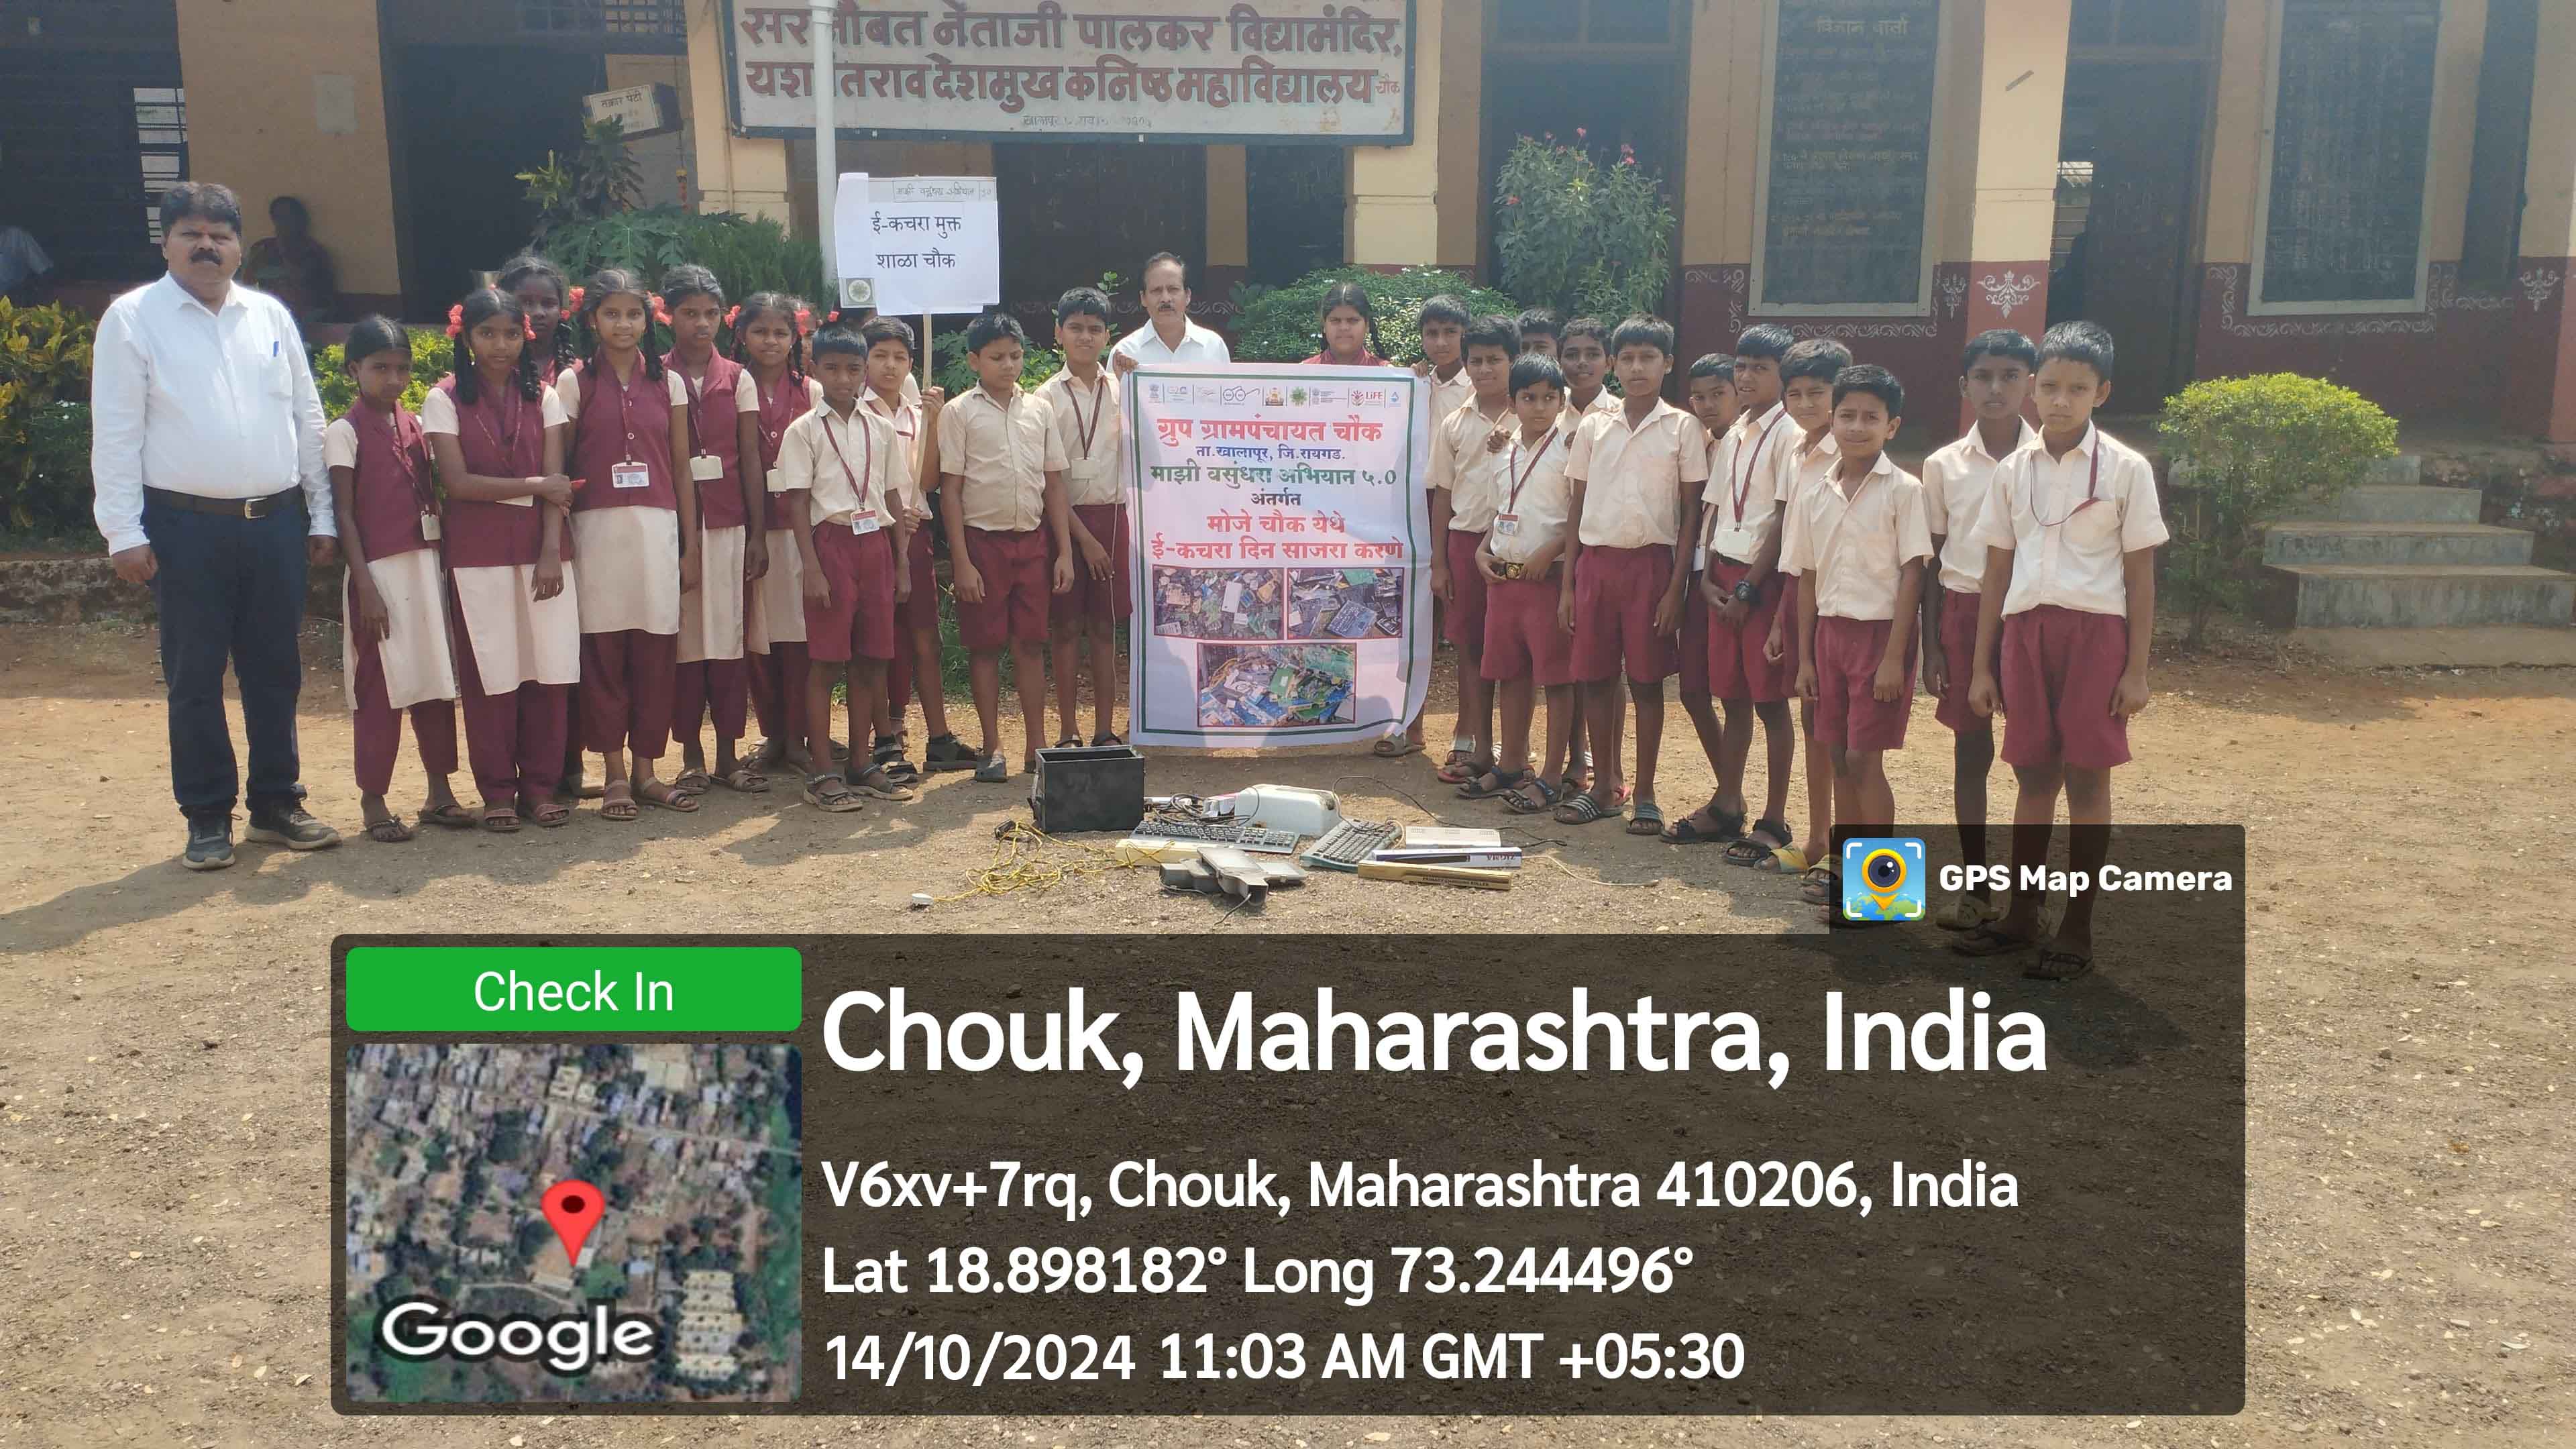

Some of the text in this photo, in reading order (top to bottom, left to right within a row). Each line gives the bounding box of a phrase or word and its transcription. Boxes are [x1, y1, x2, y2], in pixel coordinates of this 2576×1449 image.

[933, 0, 1067, 48] नेताजी
[1073, 15, 1220, 52] पालकर
[1225, 2, 1403, 58] विद्यामंदिर,
[925, 52, 1064, 113] देशमुख
[1065, 54, 1173, 103] कनिष्ठ
[1176, 54, 1379, 108] महाविद्यालय
[871, 211, 962, 239] ई-कचरा मुक्त
[875, 247, 956, 268] शाळा चौक
[1157, 413, 1383, 447] ग्रुप ग्रामपंचायत चौक
[1150, 458, 1201, 484] माझी
[1207, 460, 1273, 489] वसुंधरा
[1279, 462, 1355, 485] अभियान
[1250, 488, 1301, 506] अंतर्गत
[1258, 508, 1306, 533] चौक
[1151, 532, 1404, 559] ई-कचरा दिन साजरा करणे
